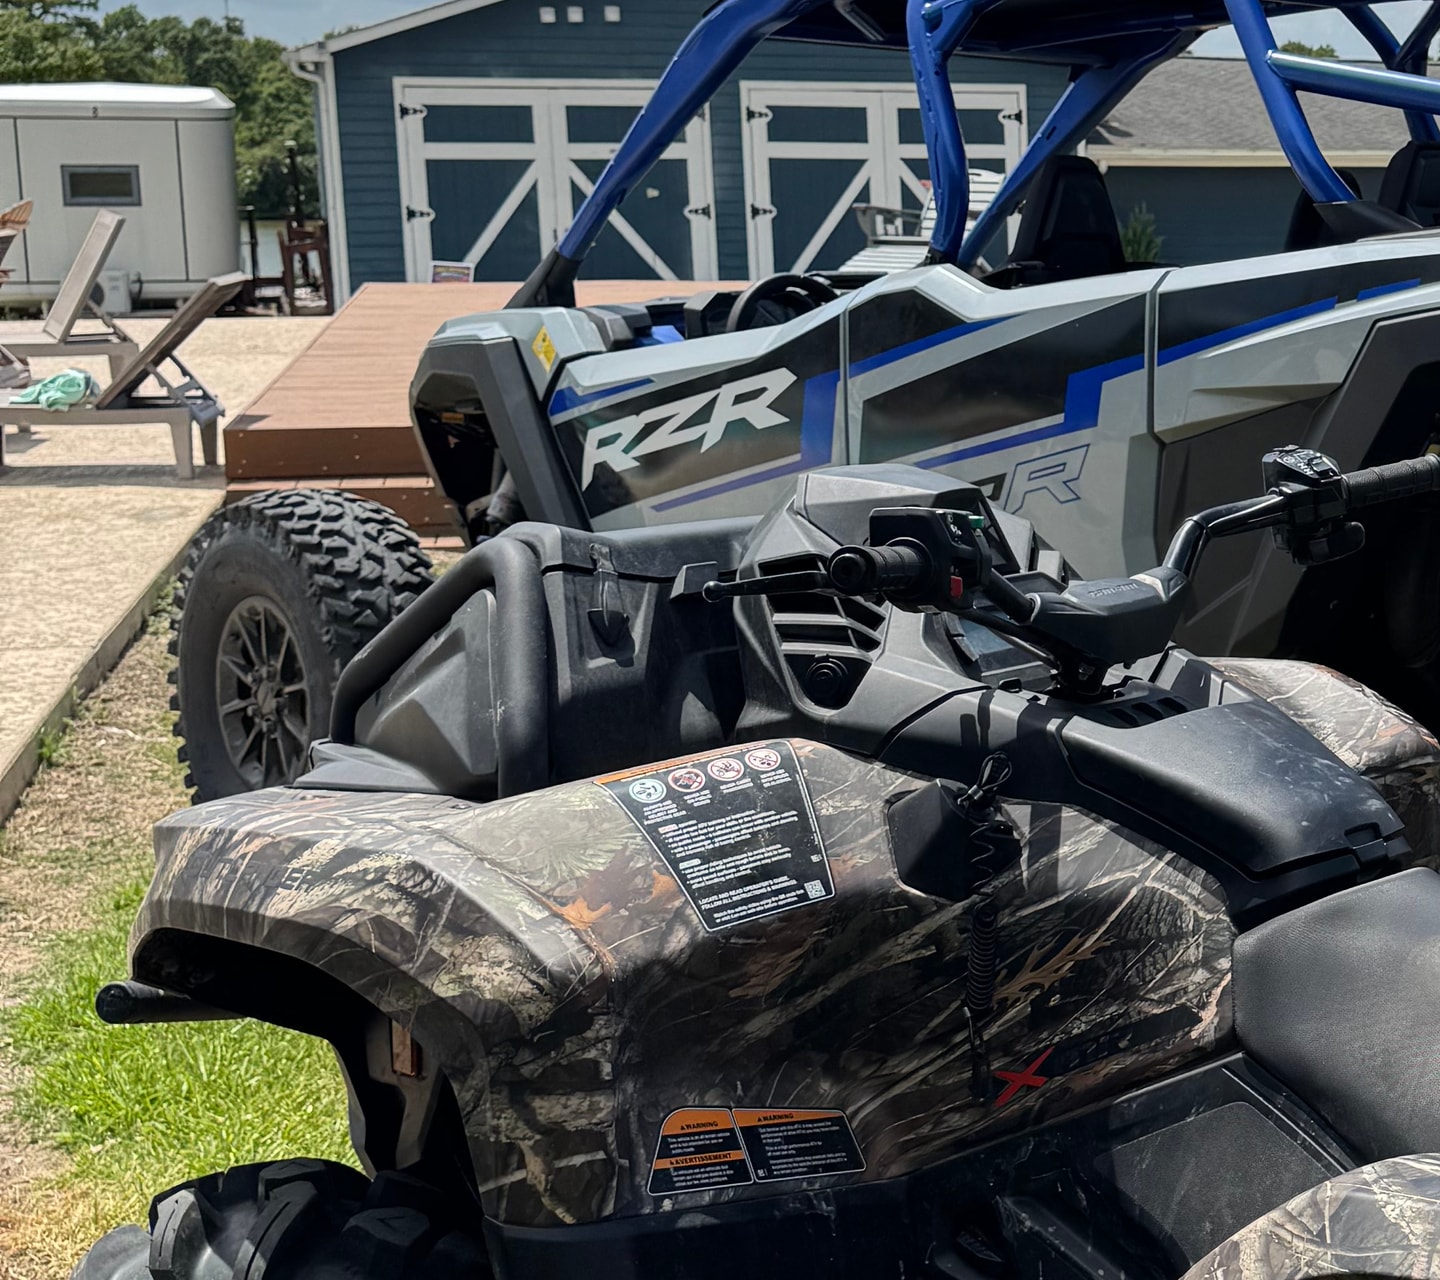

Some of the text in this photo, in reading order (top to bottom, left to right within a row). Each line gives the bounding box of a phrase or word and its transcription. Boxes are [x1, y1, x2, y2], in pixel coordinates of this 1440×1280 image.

[582, 367, 797, 491] RZR
[685, 1121, 718, 1130] WARNING
[674, 1153, 732, 1164] AVERTISSEMENT
